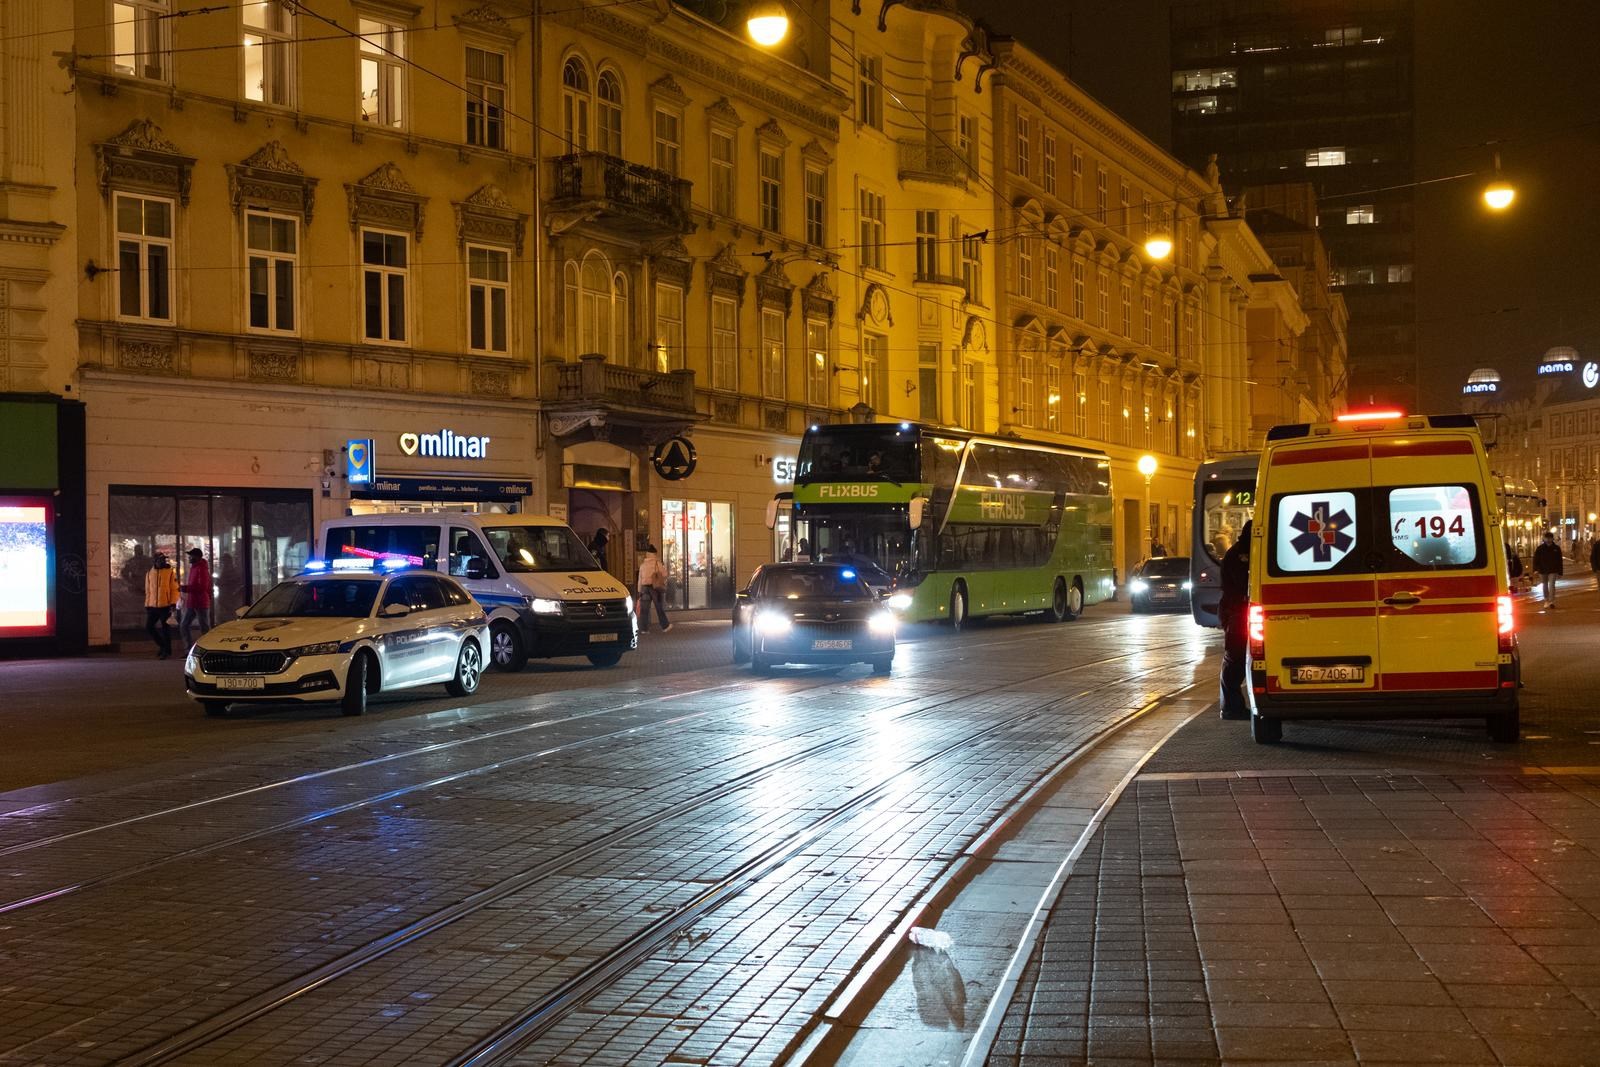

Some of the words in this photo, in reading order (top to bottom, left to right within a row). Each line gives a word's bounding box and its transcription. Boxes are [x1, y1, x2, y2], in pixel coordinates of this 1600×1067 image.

[1540, 363, 1573, 374] nama
[1466, 383, 1497, 393] nama
[419, 429, 491, 458] mlinar
[376, 481, 400, 491] mlinar
[505, 484, 527, 494] mlinar
[1236, 492, 1250, 505] 12
[1414, 515, 1465, 539] 194
[563, 586, 620, 595] POLICIJA
[219, 635, 280, 643] POLICIJA
[1299, 669, 1313, 681] ZG
